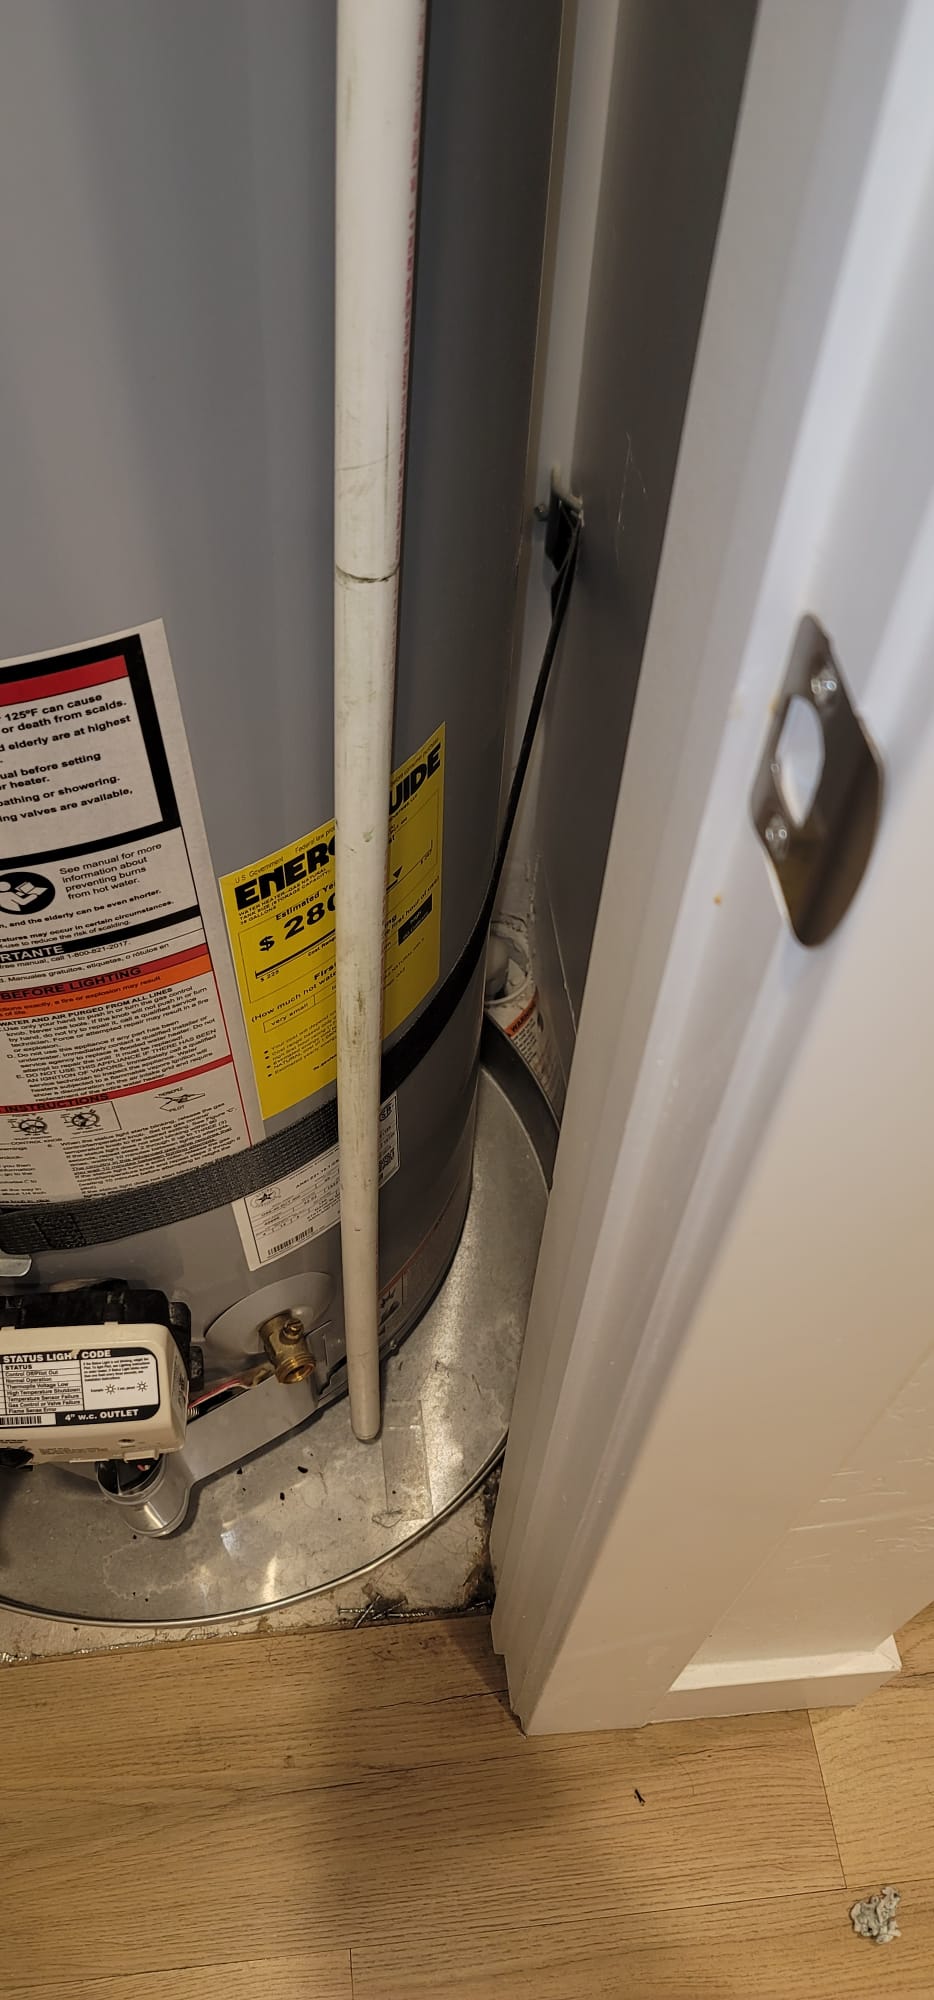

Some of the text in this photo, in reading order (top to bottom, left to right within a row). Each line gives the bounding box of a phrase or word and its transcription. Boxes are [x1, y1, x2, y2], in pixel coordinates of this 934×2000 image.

[2, 700, 127, 734] or death from scalds.
[4, 694, 102, 723] 125°F can cause
[8, 715, 131, 751] elderly are at highest
[21, 762, 58, 776] before
[61, 753, 101, 768] setting
[10, 776, 50, 790] heater.
[43, 790, 55, 799] or
[58, 776, 120, 795] showering.
[20, 788, 133, 819] valves are available,
[59, 867, 80, 875] See
[83, 856, 119, 870] manual
[137, 843, 162, 855] more
[62, 856, 148, 883] information about
[249, 857, 284, 877] Government
[65, 866, 146, 892] preventing burns
[301, 868, 326, 884] NATURAL
[68, 878, 140, 900] from hot water.
[44, 911, 74, 922] elderly
[76, 907, 92, 915] can
[107, 899, 128, 908] even
[129, 889, 162, 902] shorter.
[240, 911, 256, 920] TANK
[249, 906, 276, 921] GALLONS
[276, 890, 320, 920] Estimated
[30, 931, 47, 939] may
[50, 926, 73, 935] occur
[85, 917, 113, 928] certain
[115, 900, 174, 920] circumstances.
[31, 937, 58, 945] reduce
[98, 920, 131, 931] scalding.
[259, 935, 275, 951] $
[8, 972, 46, 983] Manuales
[48, 965, 85, 978] gratuitos,
[87, 957, 124, 970] etiquetas,
[17, 958, 50, 967] manual,
[1, 966, 142, 1000] BEFORE LIGHTING
[85, 987, 121, 999] explosion
[140, 976, 160, 985] result
[68, 1006, 104, 1016] PURGED
[106, 1000, 130, 1010] FROM
[150, 988, 173, 998] LINES
[87, 1011, 105, 1020] push
[169, 986, 193, 998] control
[251, 984, 317, 1023] (How much hot
[271, 1003, 308, 1026] very small
[3, 1355, 43, 1363] STATUS
[82, 1350, 111, 1359] CODE
[65, 1409, 139, 1421] 4" w.c. OUTLET
